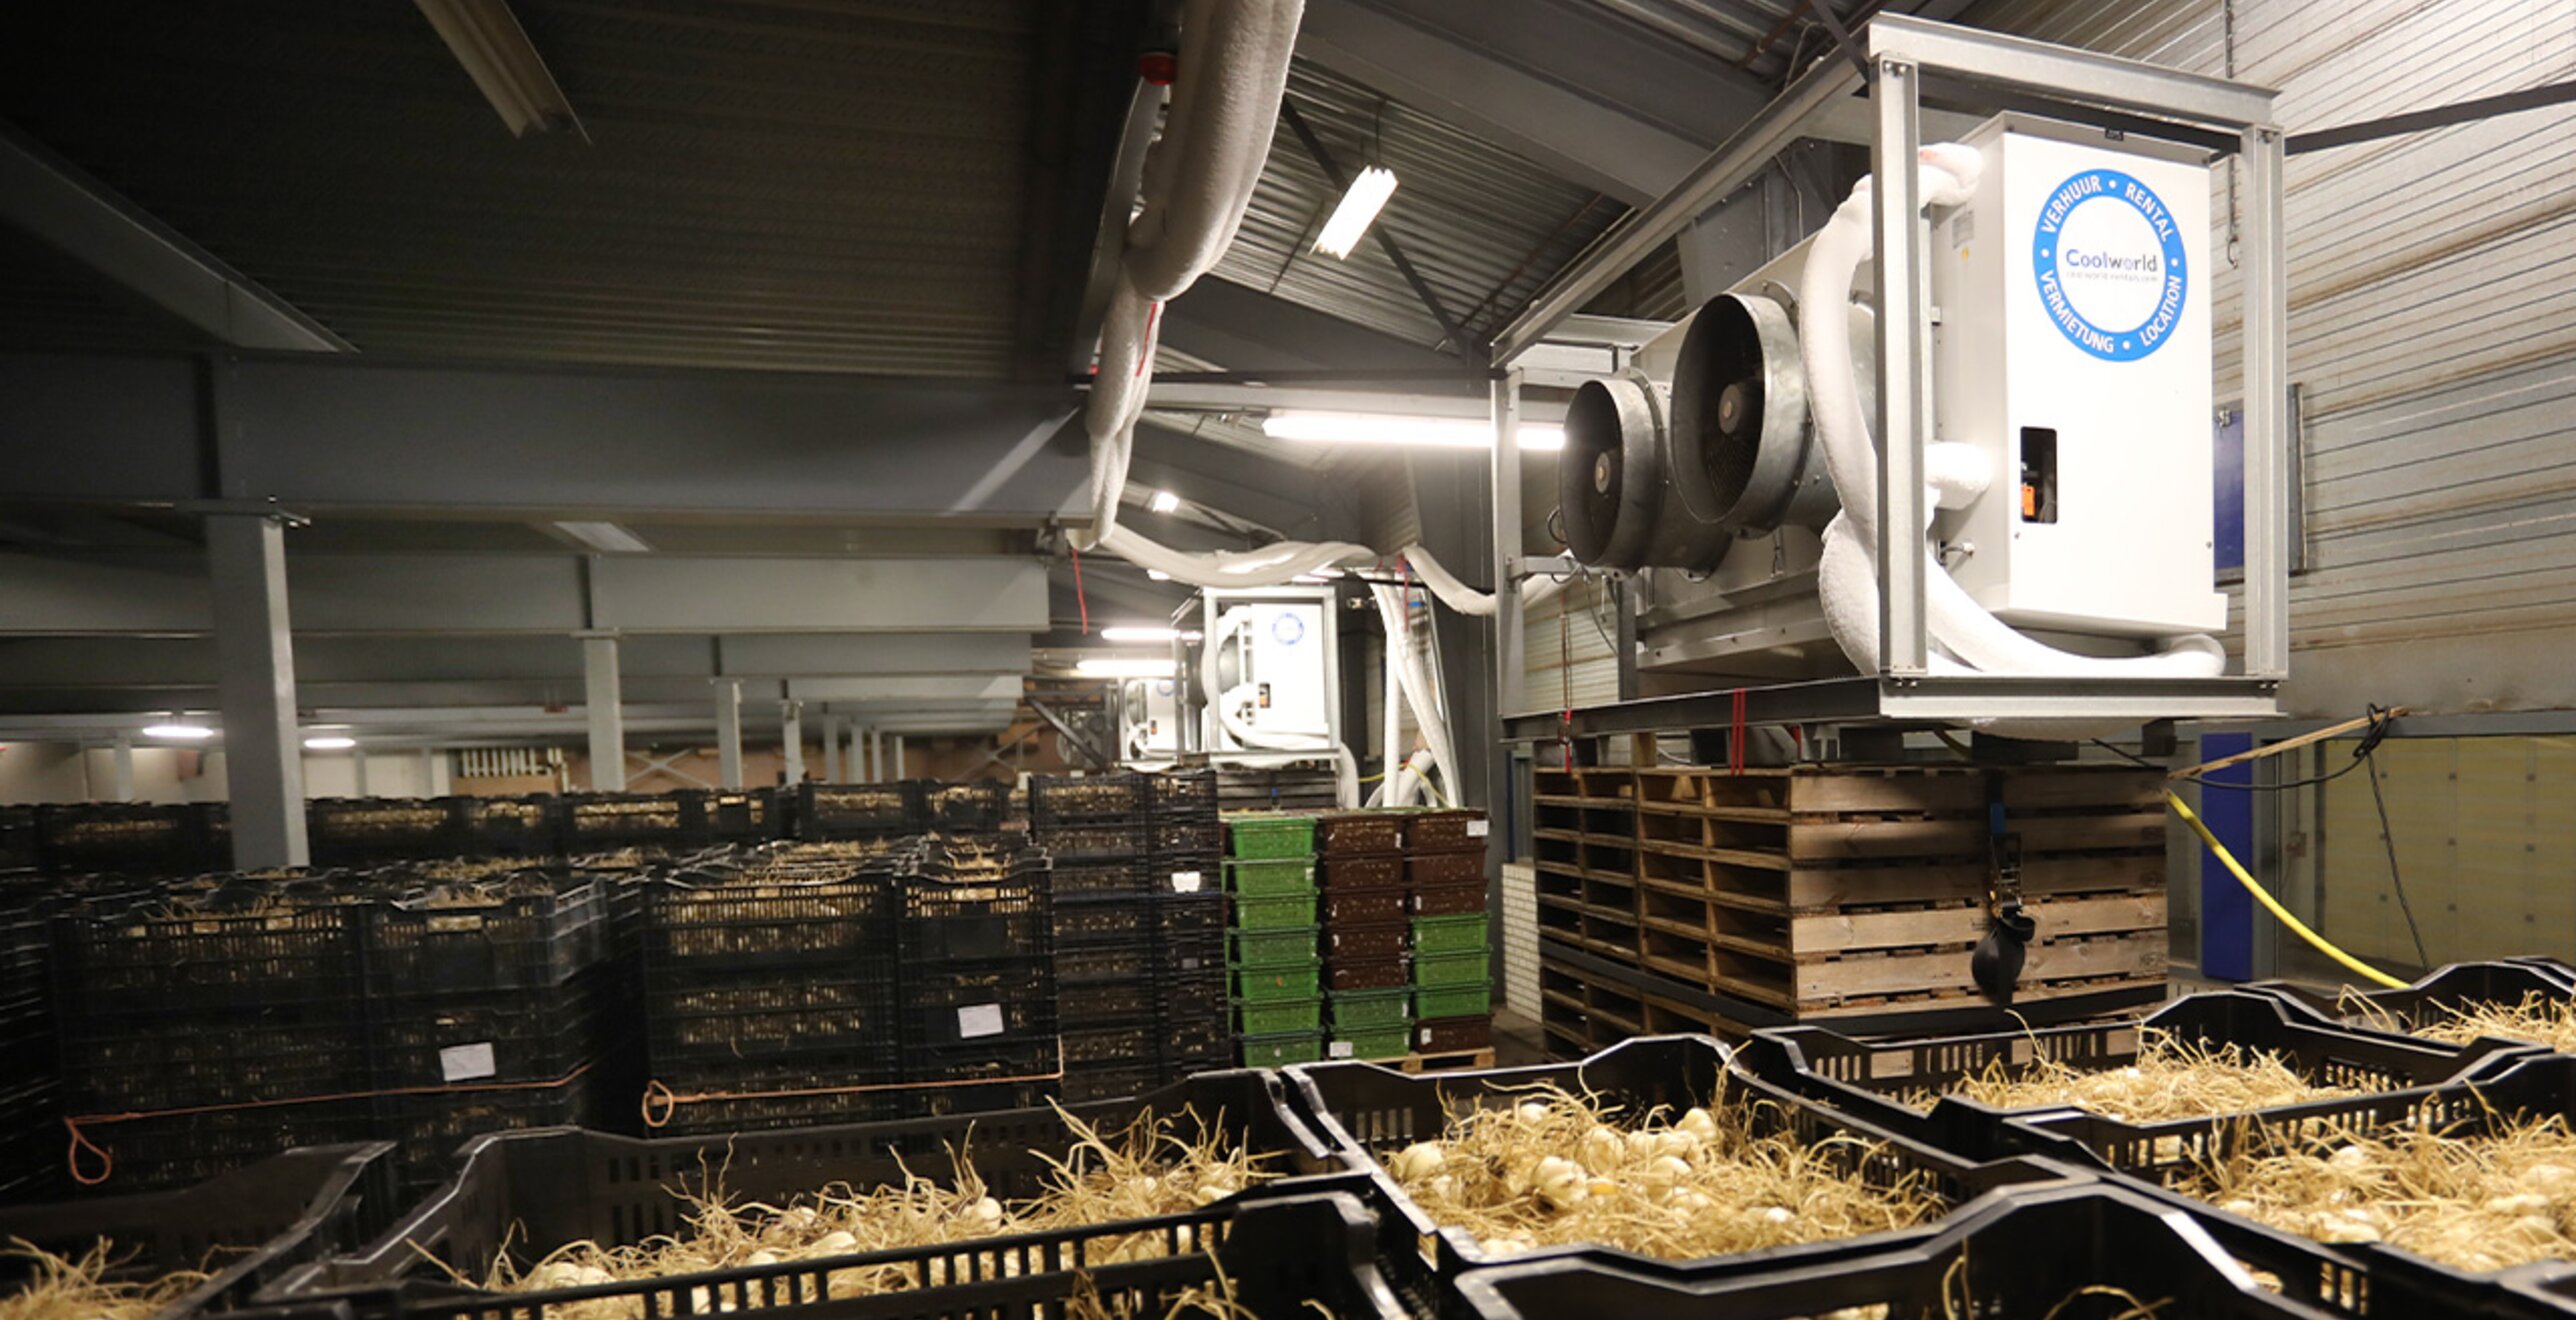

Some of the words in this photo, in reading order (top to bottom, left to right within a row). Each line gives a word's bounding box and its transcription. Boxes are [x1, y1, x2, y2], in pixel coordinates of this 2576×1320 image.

[2040, 174, 2102, 233] VERHUUR
[2124, 182, 2173, 242] RENTAL
[2066, 249, 2157, 272] Coolworld
[2040, 269, 2115, 354] VERMIETUNG
[2139, 275, 2182, 347] LOCATION
